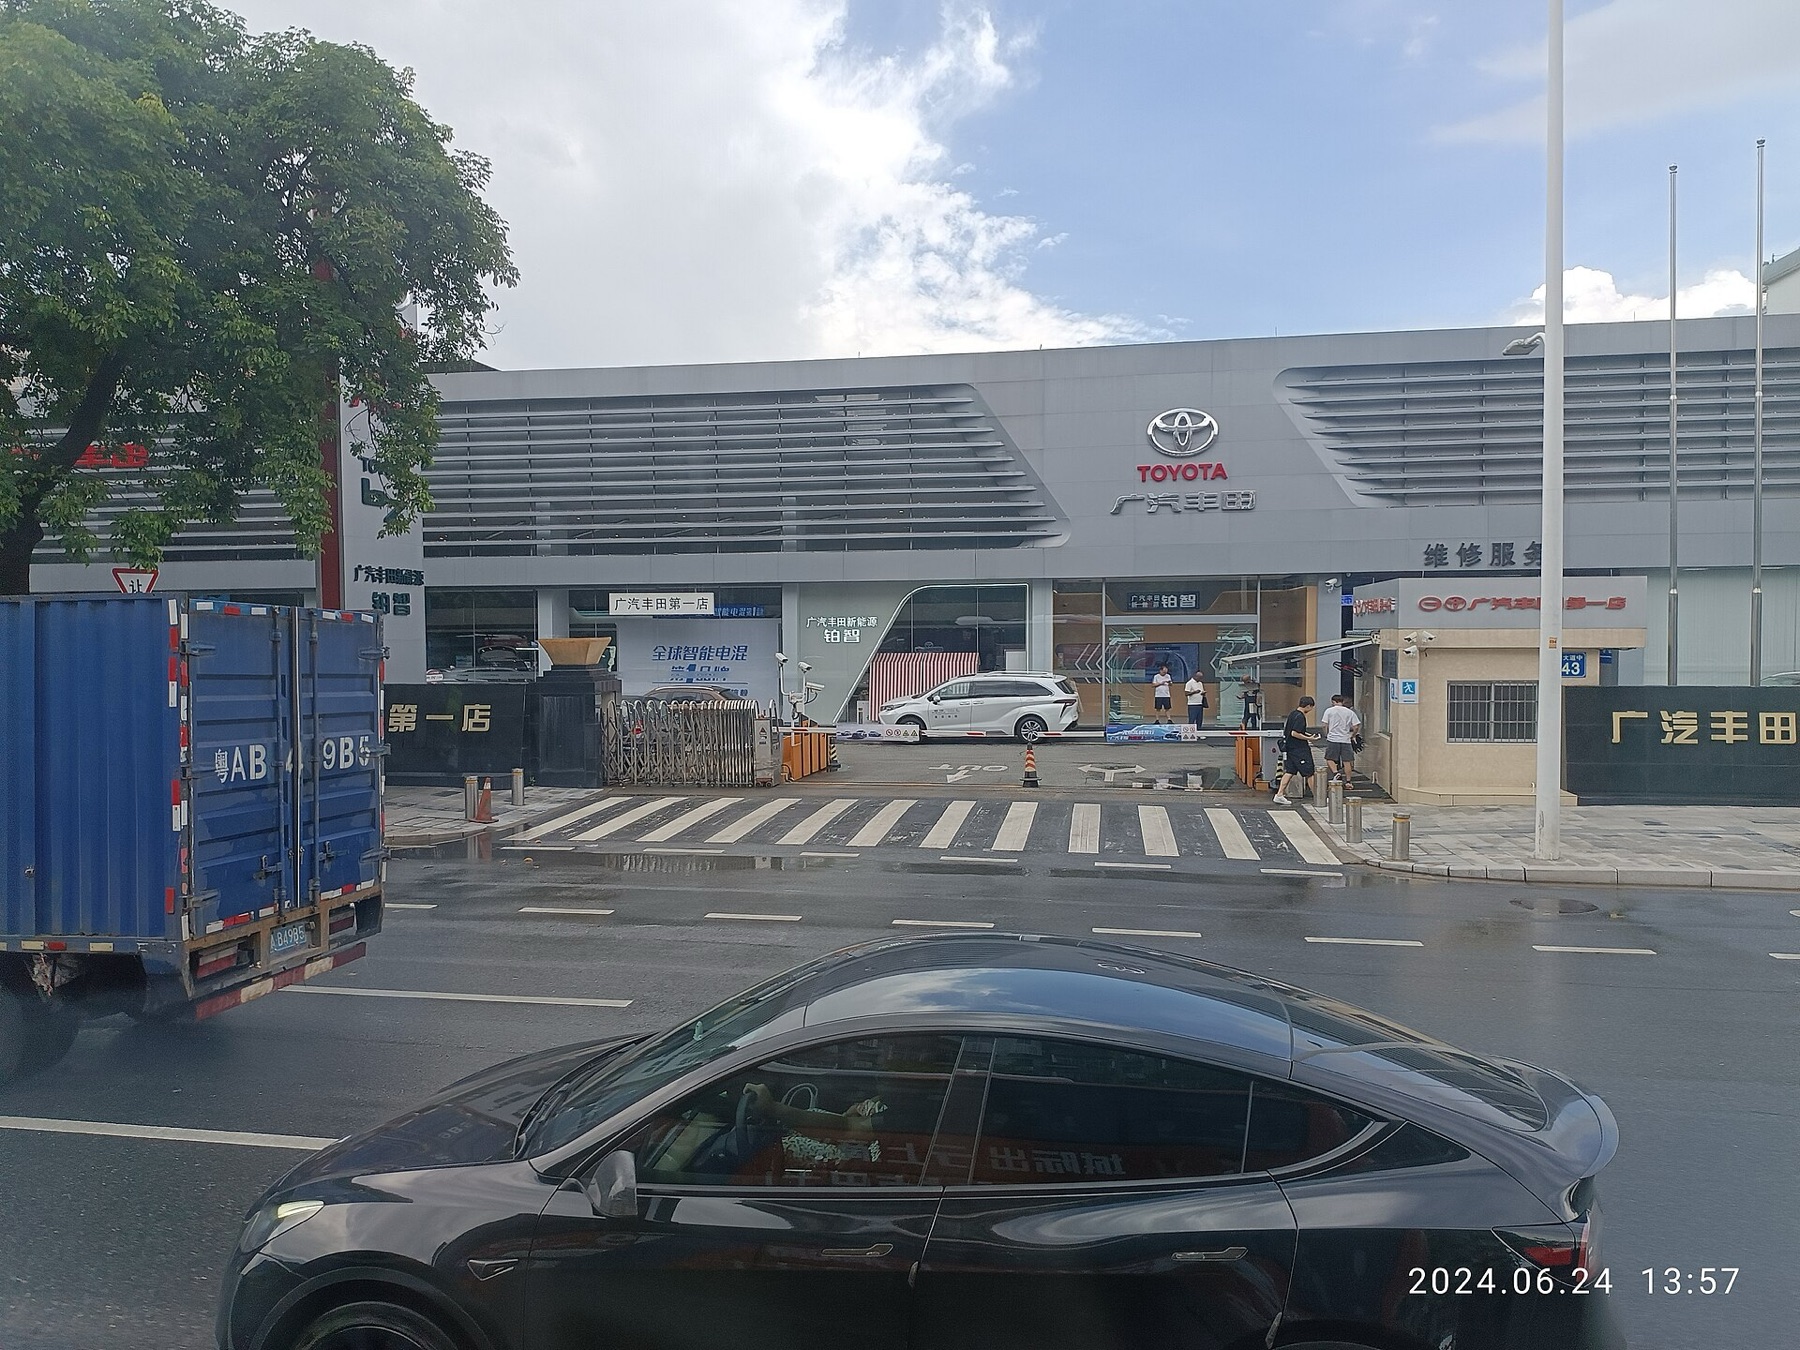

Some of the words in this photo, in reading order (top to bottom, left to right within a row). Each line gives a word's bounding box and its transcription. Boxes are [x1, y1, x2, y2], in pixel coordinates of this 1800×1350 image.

[1137, 463, 1228, 483] TOYOTA
[1110, 489, 1256, 515] 广汽丰田
[614, 597, 709, 611] 广汽丰田第一店
[1161, 594, 1196, 608] 铂智
[1467, 596, 1627, 611] 广汽丰第一店
[806, 616, 878, 628] 广汽丰田新能源
[823, 629, 860, 643] 铂智
[652, 645, 748, 661] 全球智能电混
[1561, 662, 1581, 675] 43
[388, 703, 491, 733] 第一店
[1612, 710, 1797, 745] 广汽丰田
